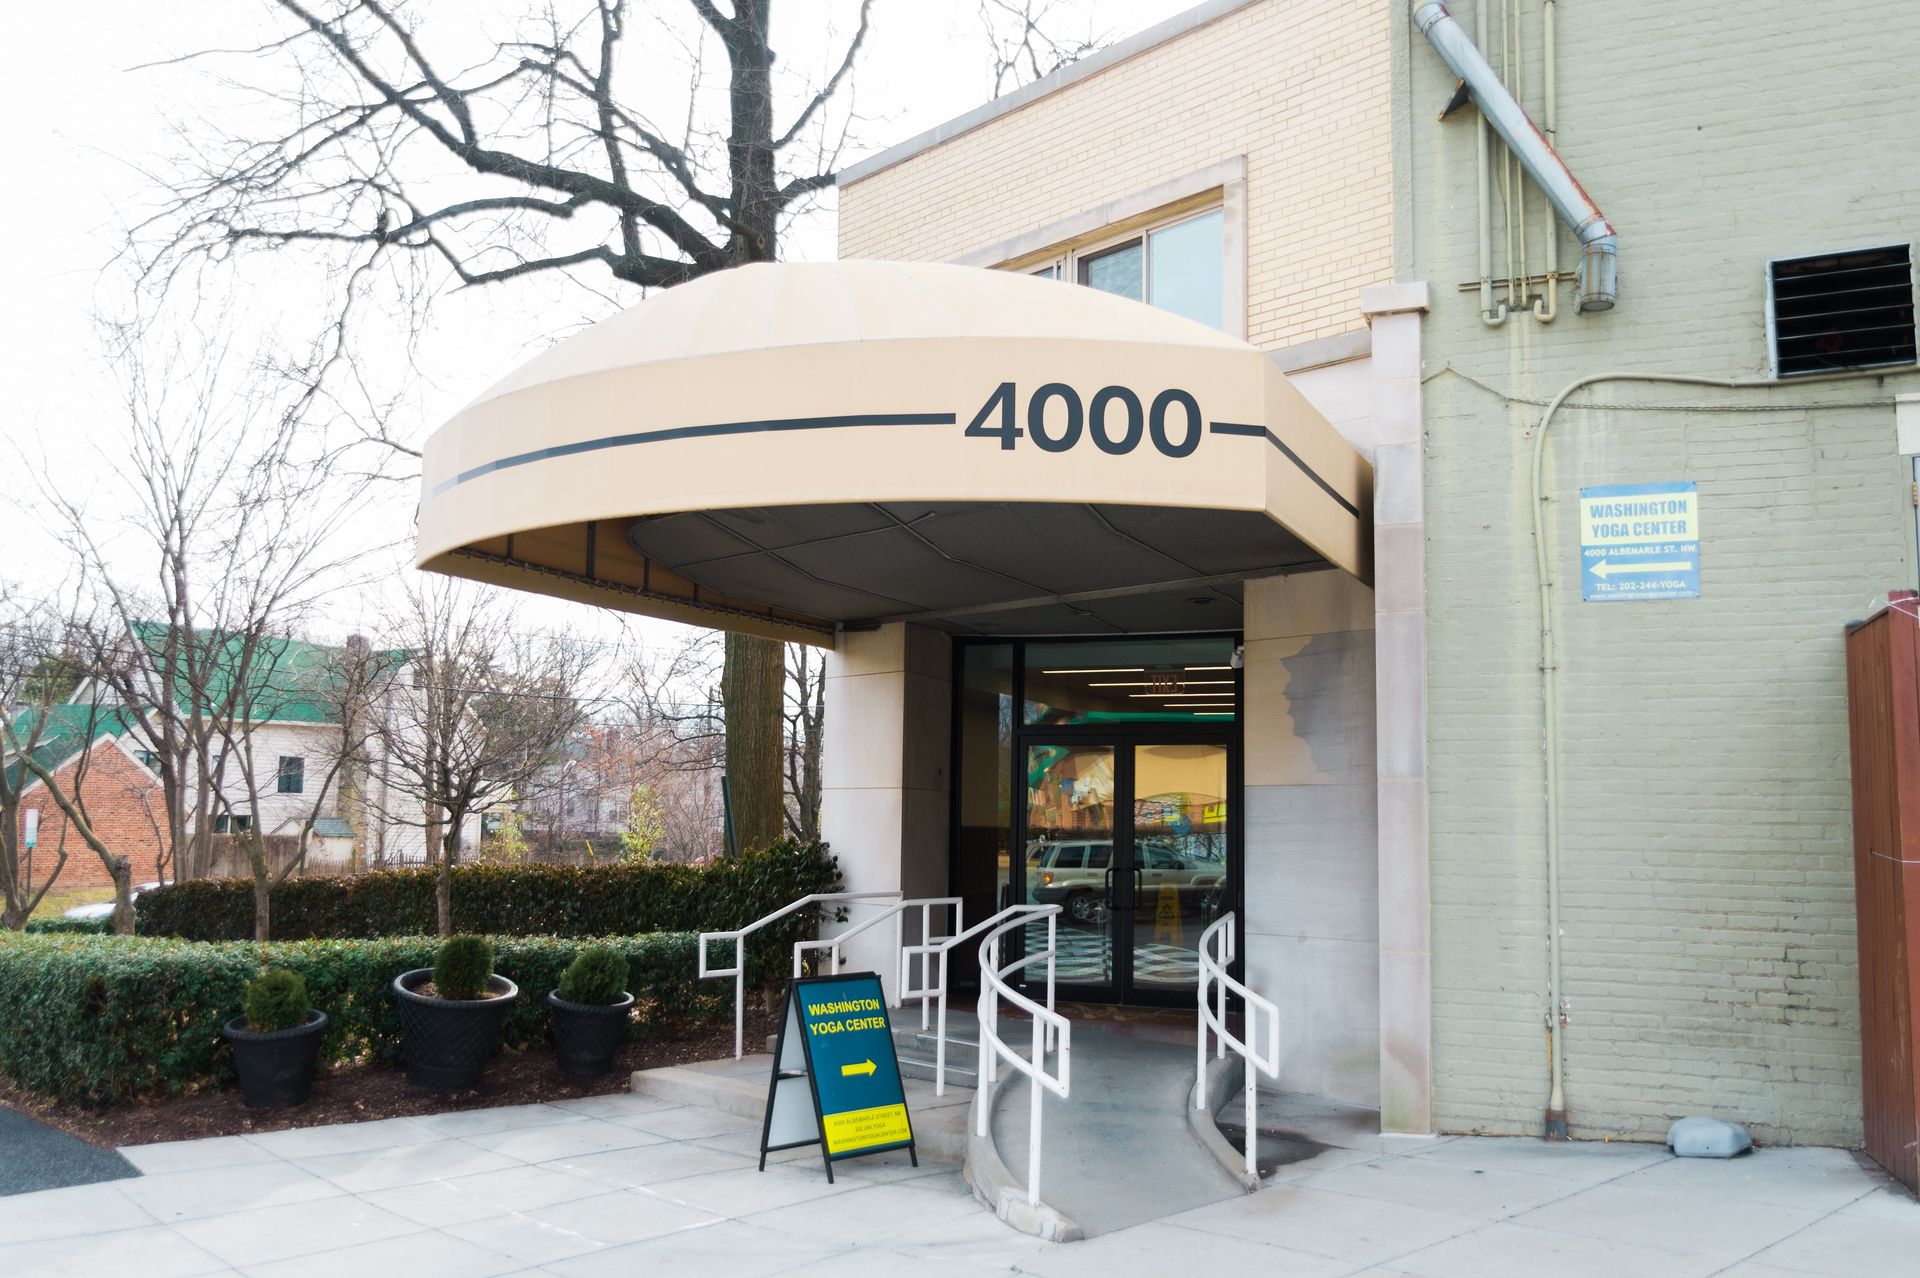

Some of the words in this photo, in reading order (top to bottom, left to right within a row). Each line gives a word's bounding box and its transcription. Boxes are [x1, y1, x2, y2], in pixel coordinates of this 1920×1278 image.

[964, 382, 1202, 458] 4000
[1590, 500, 1687, 518] WASHINGTON
[1592, 522, 1630, 538] YOGA
[1633, 520, 1687, 536] CENTER
[1584, 548, 1607, 557] 4000
[1608, 545, 1661, 556] ALBEMARLE
[1664, 545, 1677, 553] ST.
[1595, 582, 1616, 591] TEL:
[1619, 580, 1686, 591] 202-244-YOGA
[808, 998, 880, 1016] WASHINGTON
[810, 1020, 845, 1036] YOGA
[845, 1016, 886, 1031] CENTER
